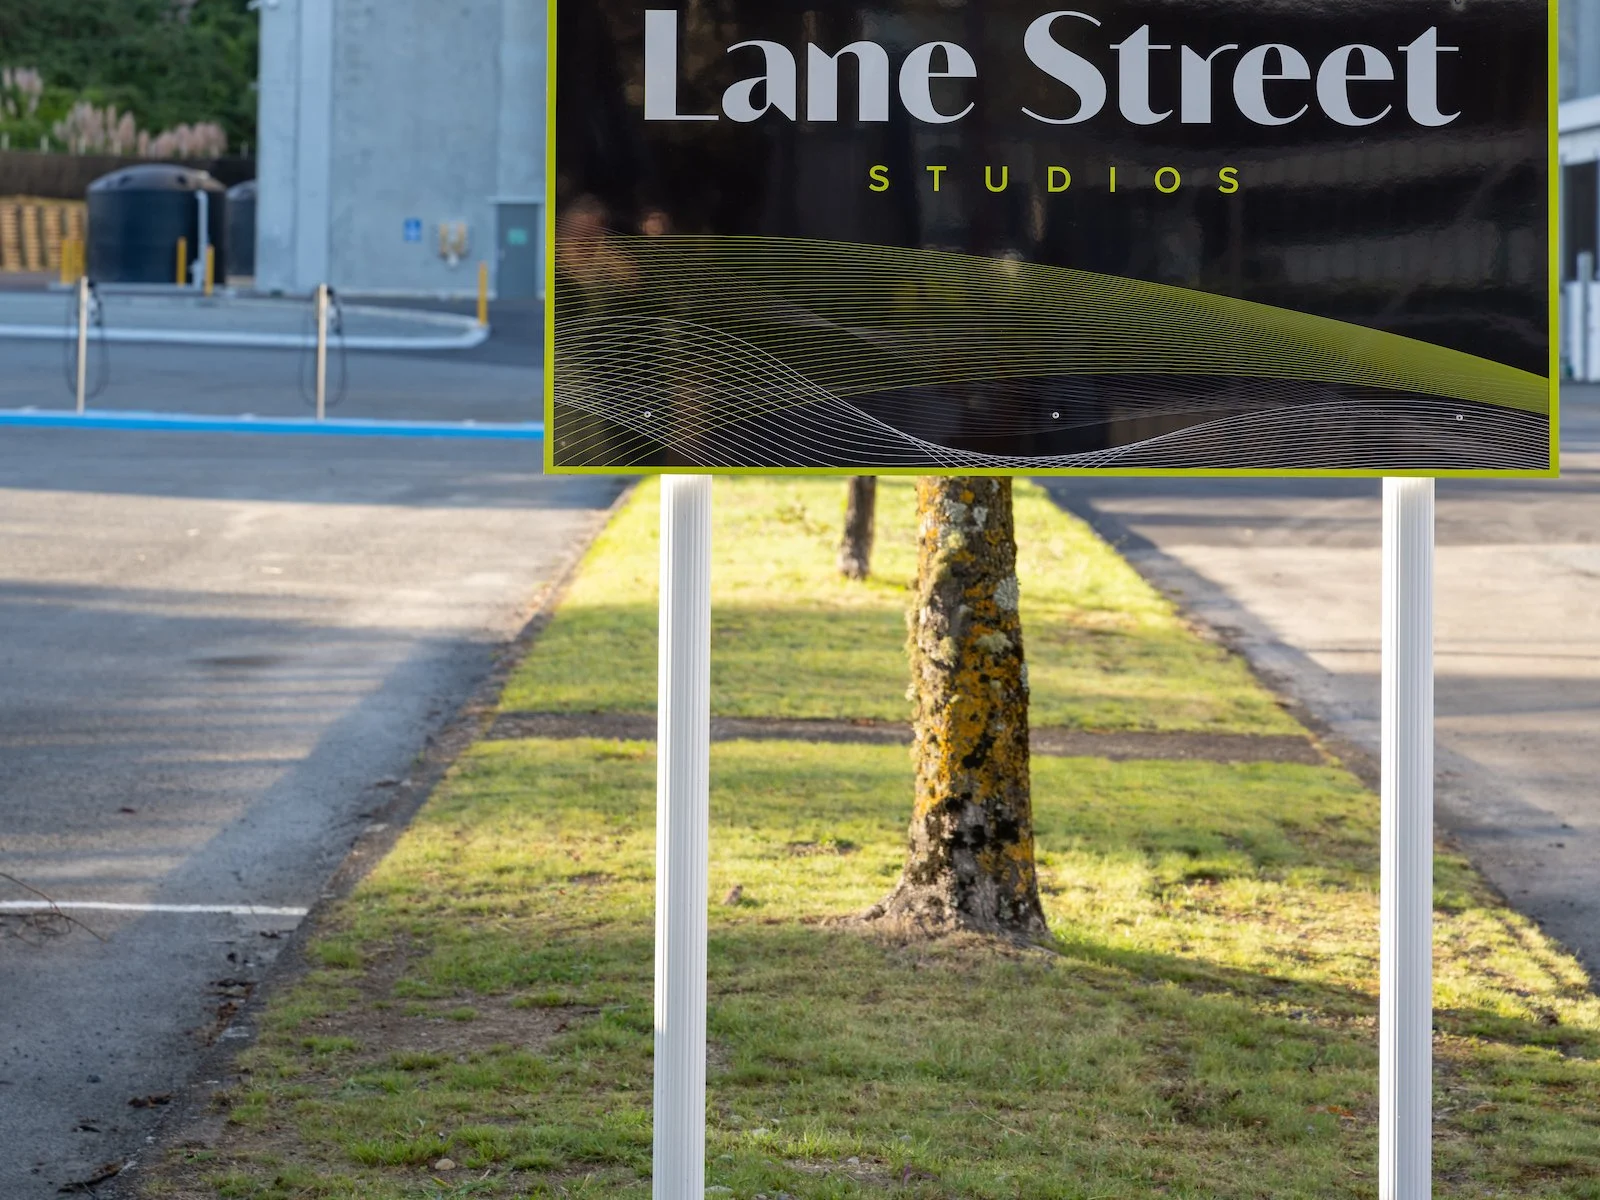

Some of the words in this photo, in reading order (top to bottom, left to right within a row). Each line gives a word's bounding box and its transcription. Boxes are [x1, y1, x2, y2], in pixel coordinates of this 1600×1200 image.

[644, 8, 977, 124] Lane
[1021, 10, 1462, 126] Street
[868, 164, 1241, 193] STUDIOS
